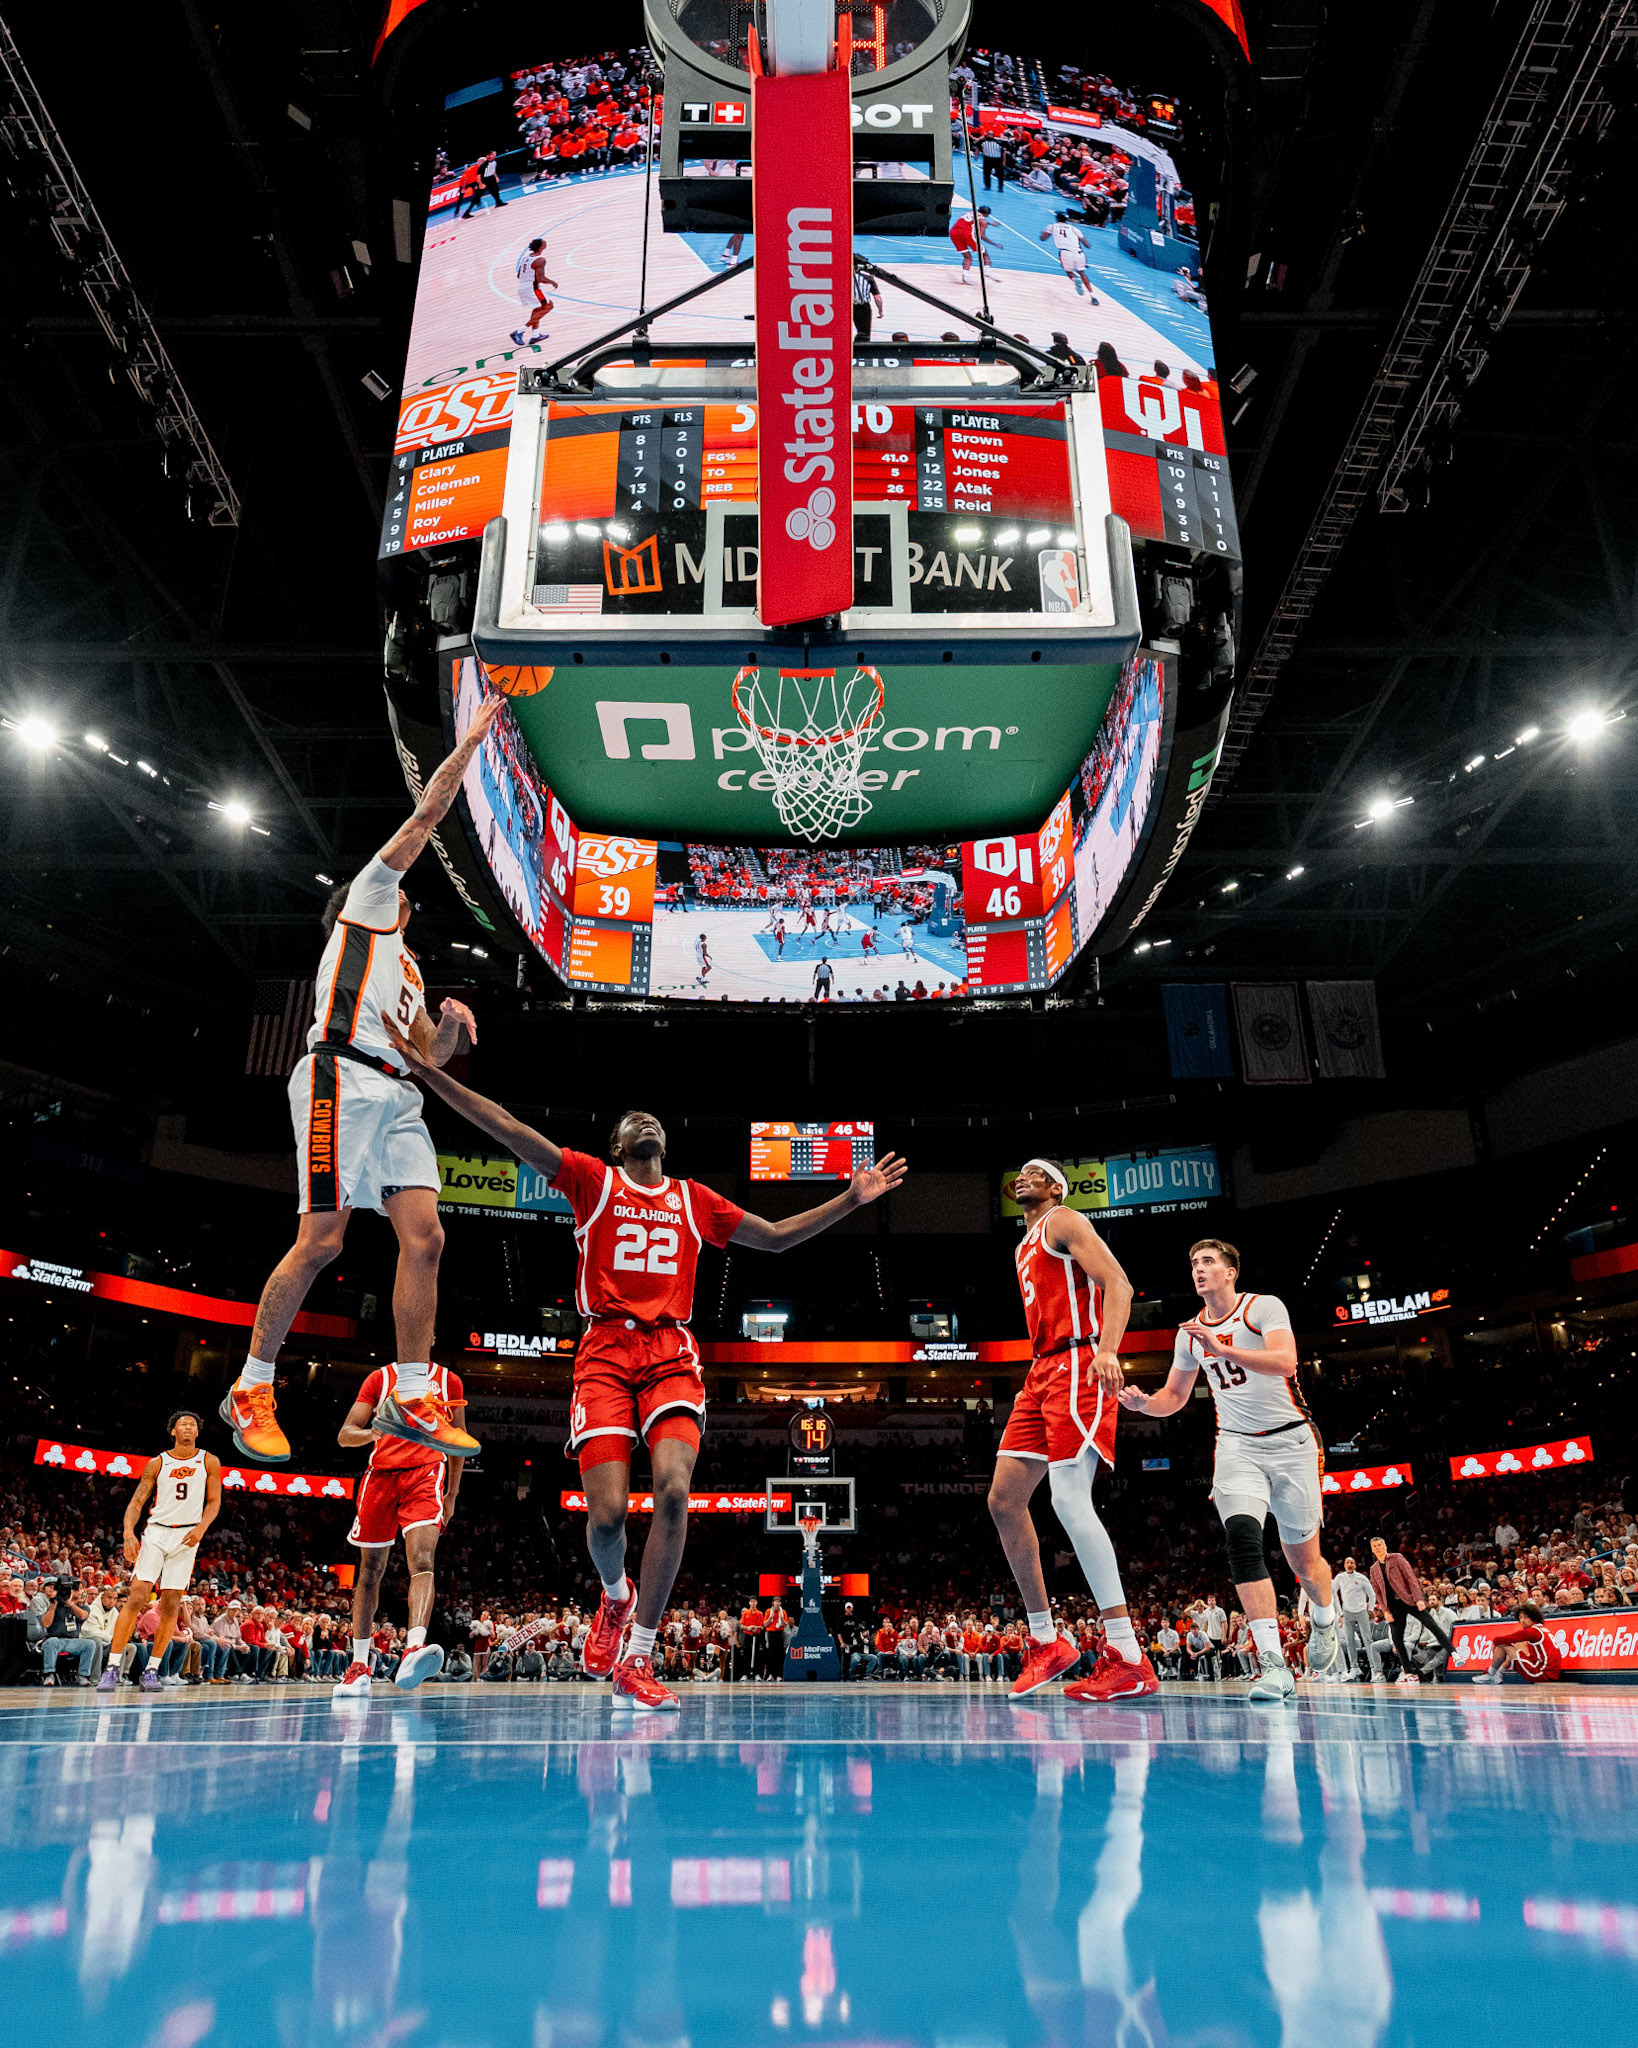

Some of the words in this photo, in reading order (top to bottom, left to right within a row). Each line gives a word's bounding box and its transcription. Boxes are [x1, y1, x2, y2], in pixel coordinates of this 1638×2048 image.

[778, 207, 834, 483] StateFarm
[632, 415, 651, 425] PTS
[674, 412, 693, 422] FLS
[952, 414, 1000, 430] PLAYER
[635, 435, 646, 446] 8
[677, 431, 688, 442] 2
[928, 431, 935, 441] 1
[951, 432, 1003, 447] Brown
[422, 442, 465, 463] PLAYER
[637, 450, 644, 460] 1
[676, 447, 687, 458] 0
[707, 453, 736, 461] FG%
[881, 453, 909, 463] 41.0
[927, 447, 936, 458] 5
[951, 448, 1008, 464] Wague
[1166, 448, 1185, 461] PTS
[1203, 458, 1220, 471] FLS
[398, 476, 405, 486] 1
[419, 465, 456, 481] Clary
[634, 467, 644, 477] 7
[678, 464, 684, 474] 1
[707, 468, 725, 477] TO
[891, 468, 900, 477] 5
[923, 463, 941, 475] 12
[952, 465, 1000, 479] Jones
[1168, 466, 1185, 478] 10
[1210, 475, 1217, 486] 1
[394, 492, 404, 502] 4
[417, 475, 480, 496] Coleman
[629, 483, 647, 494] 13
[674, 480, 686, 491] 0
[706, 483, 733, 492] REB
[887, 484, 904, 494] 26
[923, 480, 943, 491] 22
[954, 482, 993, 496] Atak
[1174, 482, 1184, 493] 4
[1212, 491, 1219, 502] 1
[392, 508, 402, 519] 5
[414, 496, 455, 513] Miller
[631, 500, 643, 511] 4
[673, 498, 685, 508] 0
[923, 497, 943, 508] 35
[954, 499, 991, 513] Reid
[1175, 498, 1186, 509] 9
[1214, 507, 1221, 518] 1
[390, 525, 400, 536] 9
[413, 516, 441, 529] Roy
[1178, 514, 1188, 525] 3
[1216, 523, 1223, 534] 1
[385, 541, 400, 553] 19
[411, 526, 468, 545] Vukovic
[1180, 531, 1190, 543] 5
[1216, 540, 1227, 551] 0
[908, 542, 1014, 592] BANK
[1048, 601, 1066, 612] NBA
[551, 856, 566, 896] 46
[1051, 856, 1065, 898] 39
[598, 884, 630, 916] 39
[986, 886, 1021, 917] 46
[575, 918, 595, 926] PLAYER
[967, 925, 987, 933] PLAYER
[397, 984, 413, 1026] 5
[312, 1098, 332, 1174] COWBOYS
[773, 1125, 790, 1135] 39
[834, 1124, 853, 1135] 46
[1068, 1177, 1107, 1195] ves
[1113, 1161, 1163, 1200] LOUD
[1171, 1159, 1215, 1190] CITY
[457, 1206, 481, 1216] THE
[483, 1208, 538, 1221] THUNDER
[613, 1204, 682, 1226] OKLAHOMA
[1083, 1208, 1133, 1220] HUNDER
[1151, 1203, 1176, 1214] EXIT
[1180, 1200, 1208, 1211] NOW
[613, 1222, 679, 1276] 22
[30, 1259, 71, 1277] PRESENTED
[72, 1268, 83, 1278] BY
[30, 1268, 94, 1293] StateFarm
[1350, 1291, 1431, 1320] BEDLAM
[1368, 1310, 1417, 1325] BASKETBALL
[484, 1332, 556, 1352] BEDLAM
[498, 1348, 541, 1359] BASKETBALL
[927, 1350, 978, 1361] StateFarm
[1210, 1359, 1247, 1391] 19
[801, 1419, 826, 1431] 16:16
[806, 1430, 825, 1449] 14
[175, 1482, 188, 1500] 9
[731, 1497, 786, 1508] StateFarm
[507, 1621, 543, 1649] DEFENSE
[1569, 1626, 1638, 1658] StateFar
